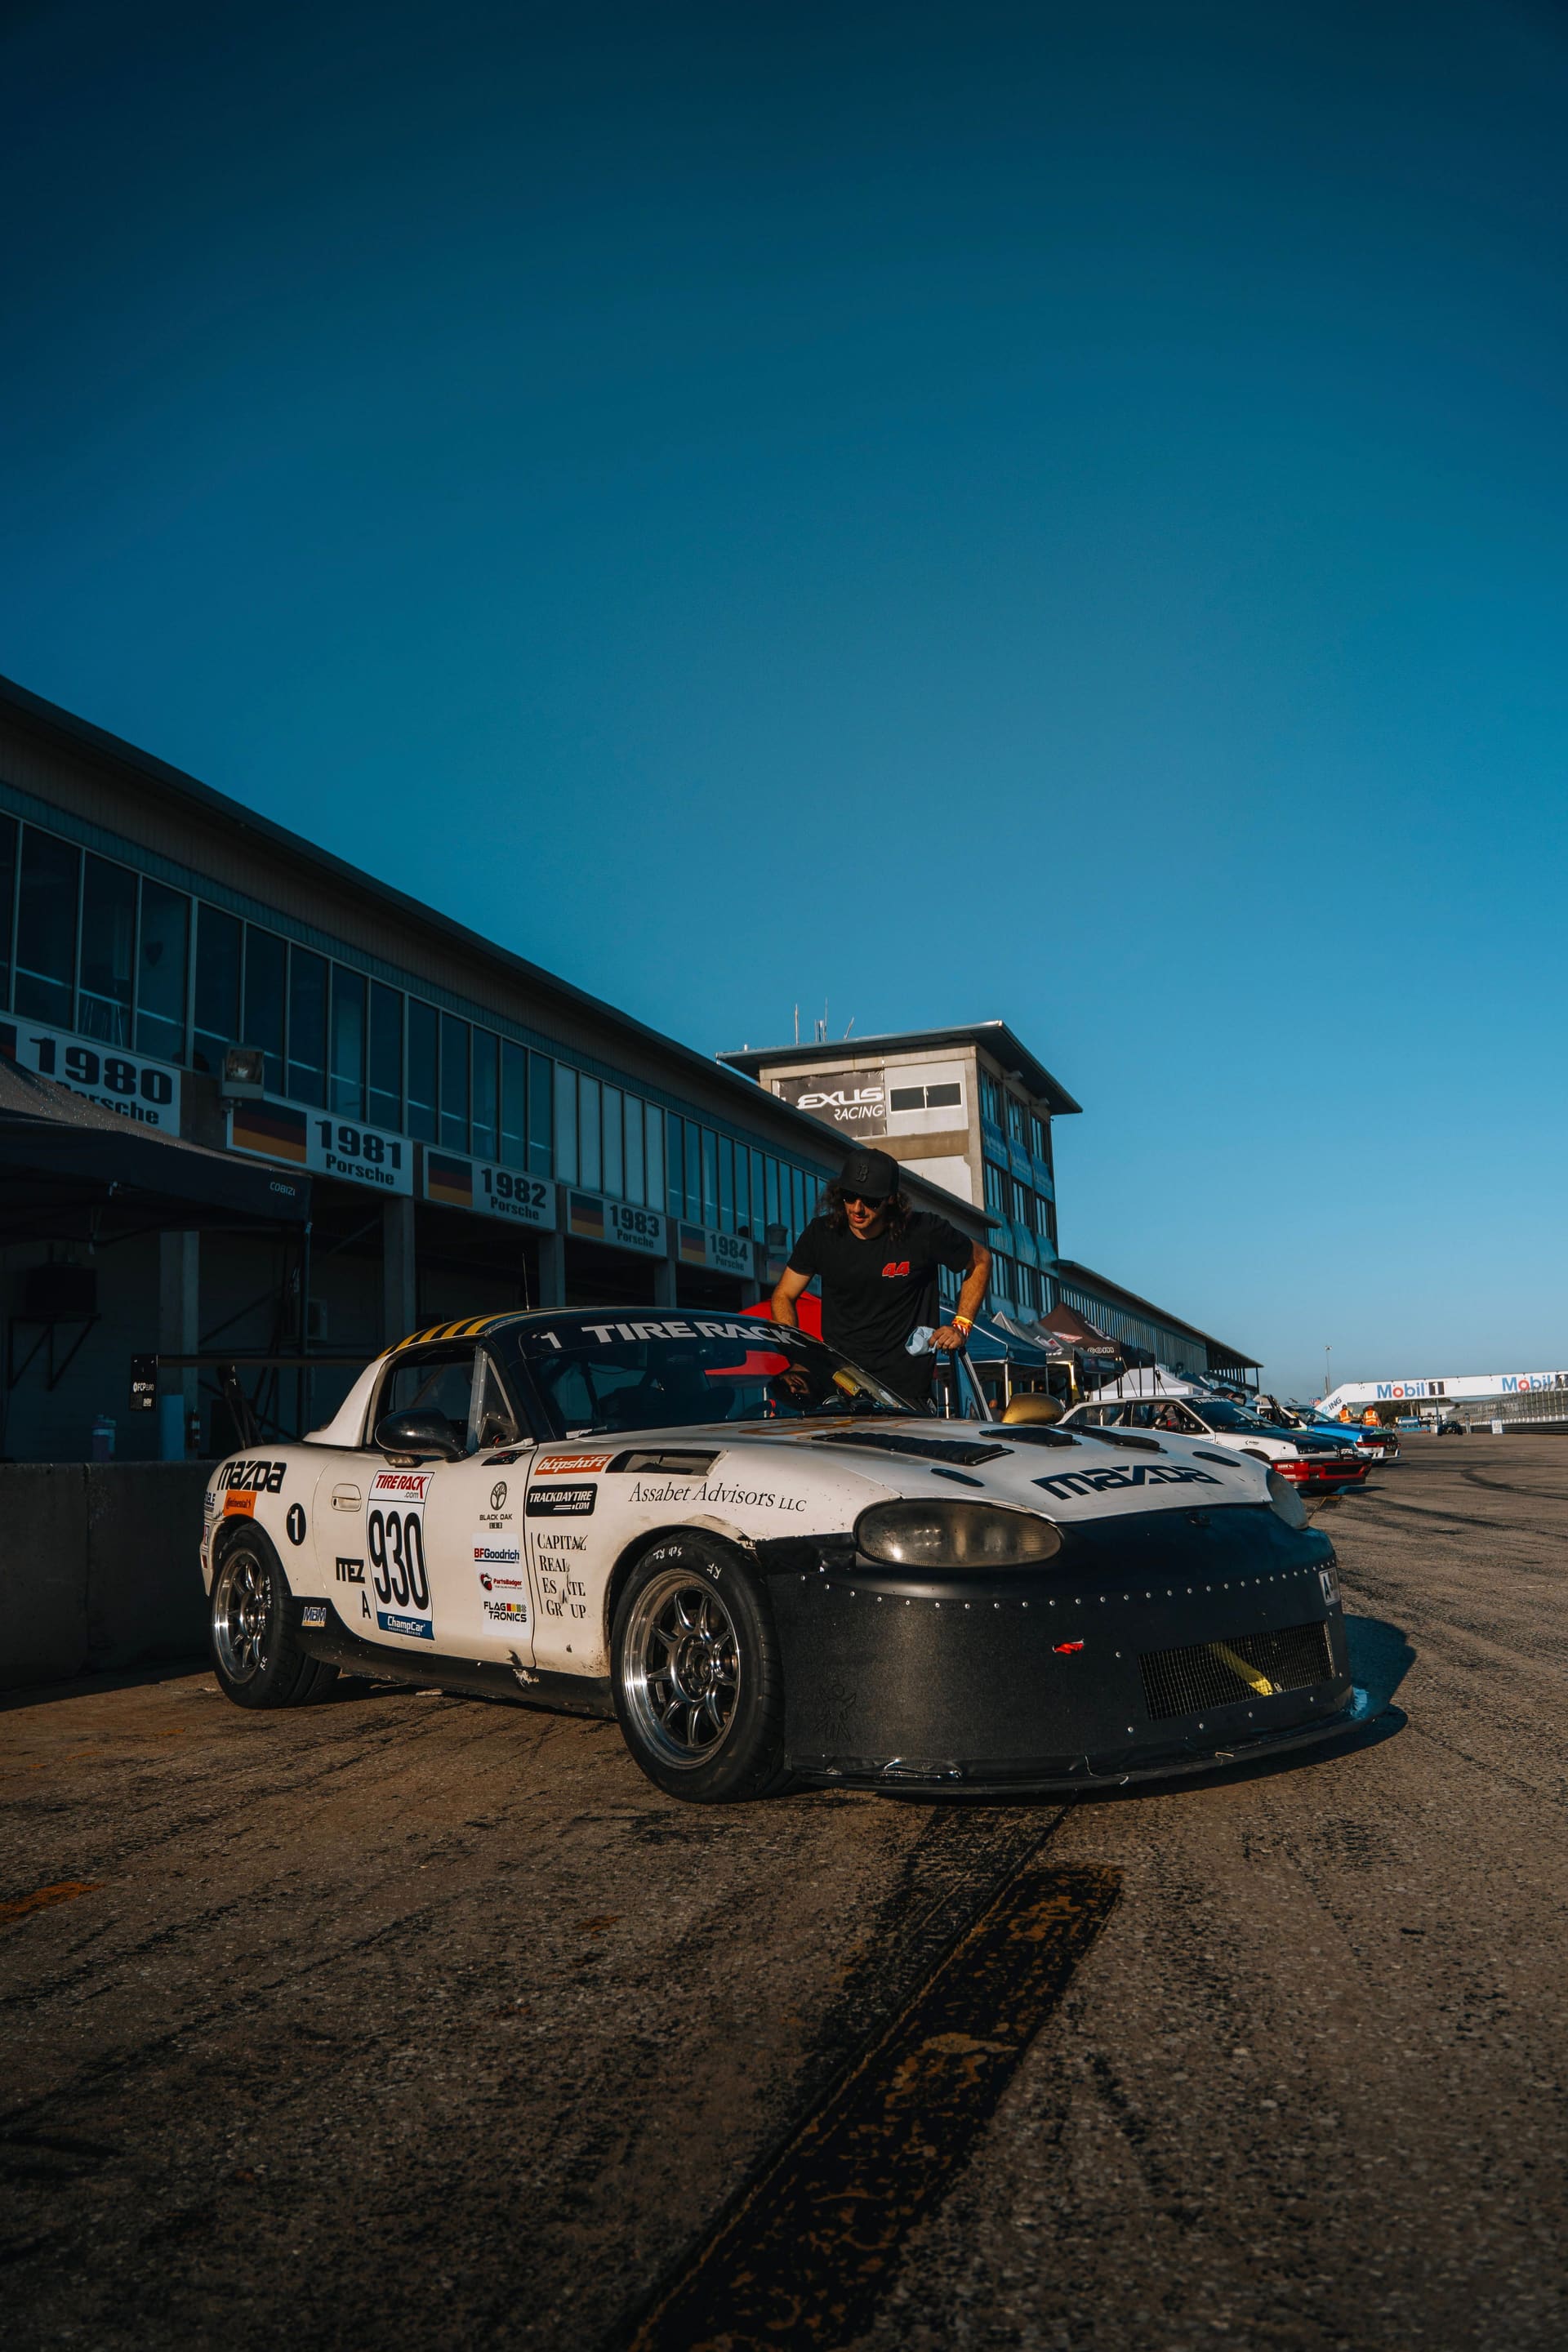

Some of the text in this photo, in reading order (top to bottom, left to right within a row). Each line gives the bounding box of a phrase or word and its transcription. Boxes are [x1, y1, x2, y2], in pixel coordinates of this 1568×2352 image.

[29, 1036, 173, 1106] 1980
[56, 1080, 159, 1125] rsche
[782, 1086, 884, 1110] EXUS
[834, 1104, 884, 1121] RACING
[314, 1120, 401, 1170] 1981
[327, 1153, 394, 1186] Porsche
[480, 1168, 546, 1209] 1982
[491, 1195, 539, 1221] Porsche
[609, 1205, 660, 1237] 1983
[617, 1229, 654, 1249] Porsche
[710, 1234, 749, 1262] 1984
[715, 1255, 745, 1271] Porsche
[882, 1261, 910, 1277] 44
[540, 1321, 807, 1349] 1 TIRE RACK
[1376, 1382, 1425, 1399] Mobil
[1502, 1374, 1552, 1392] Mobil
[537, 1456, 609, 1473] blipshift
[216, 1460, 287, 1494] mazda
[376, 1475, 427, 1499] TIRE RACK
[1030, 1464, 1225, 1500] mazda
[529, 1491, 594, 1503] TRACKDAYTIRE
[628, 1481, 807, 1512] Assabet Advisors LLC
[291, 1509, 299, 1541] 1
[368, 1509, 430, 1611] 930
[474, 1548, 520, 1561] BFGoodrich
[493, 1578, 523, 1587] PartsBadger
[362, 1590, 372, 1619] A
[483, 1601, 506, 1612] FLAG
[546, 1599, 586, 1619] GRUP
[387, 1615, 425, 1633] ChampCar
[488, 1611, 528, 1624] TRONICS
